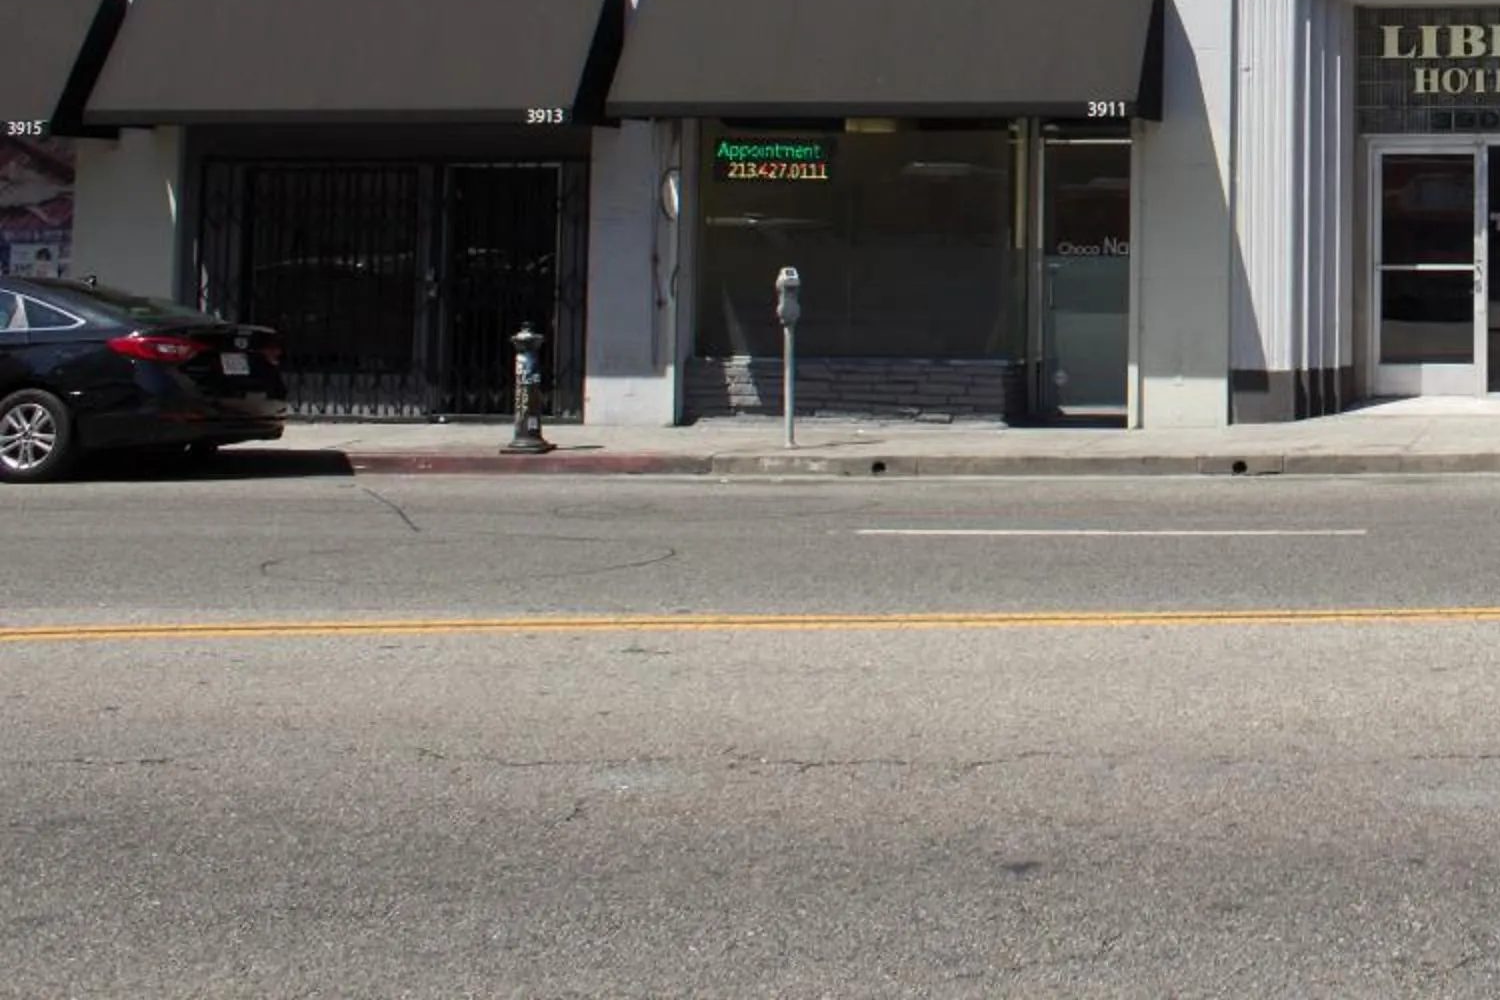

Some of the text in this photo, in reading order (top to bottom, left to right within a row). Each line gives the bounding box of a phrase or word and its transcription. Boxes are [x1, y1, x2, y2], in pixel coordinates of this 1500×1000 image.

[526, 107, 564, 125] 3913
[1087, 101, 1126, 117] 3911
[7, 120, 43, 137] 3915
[717, 141, 823, 160] Appointment
